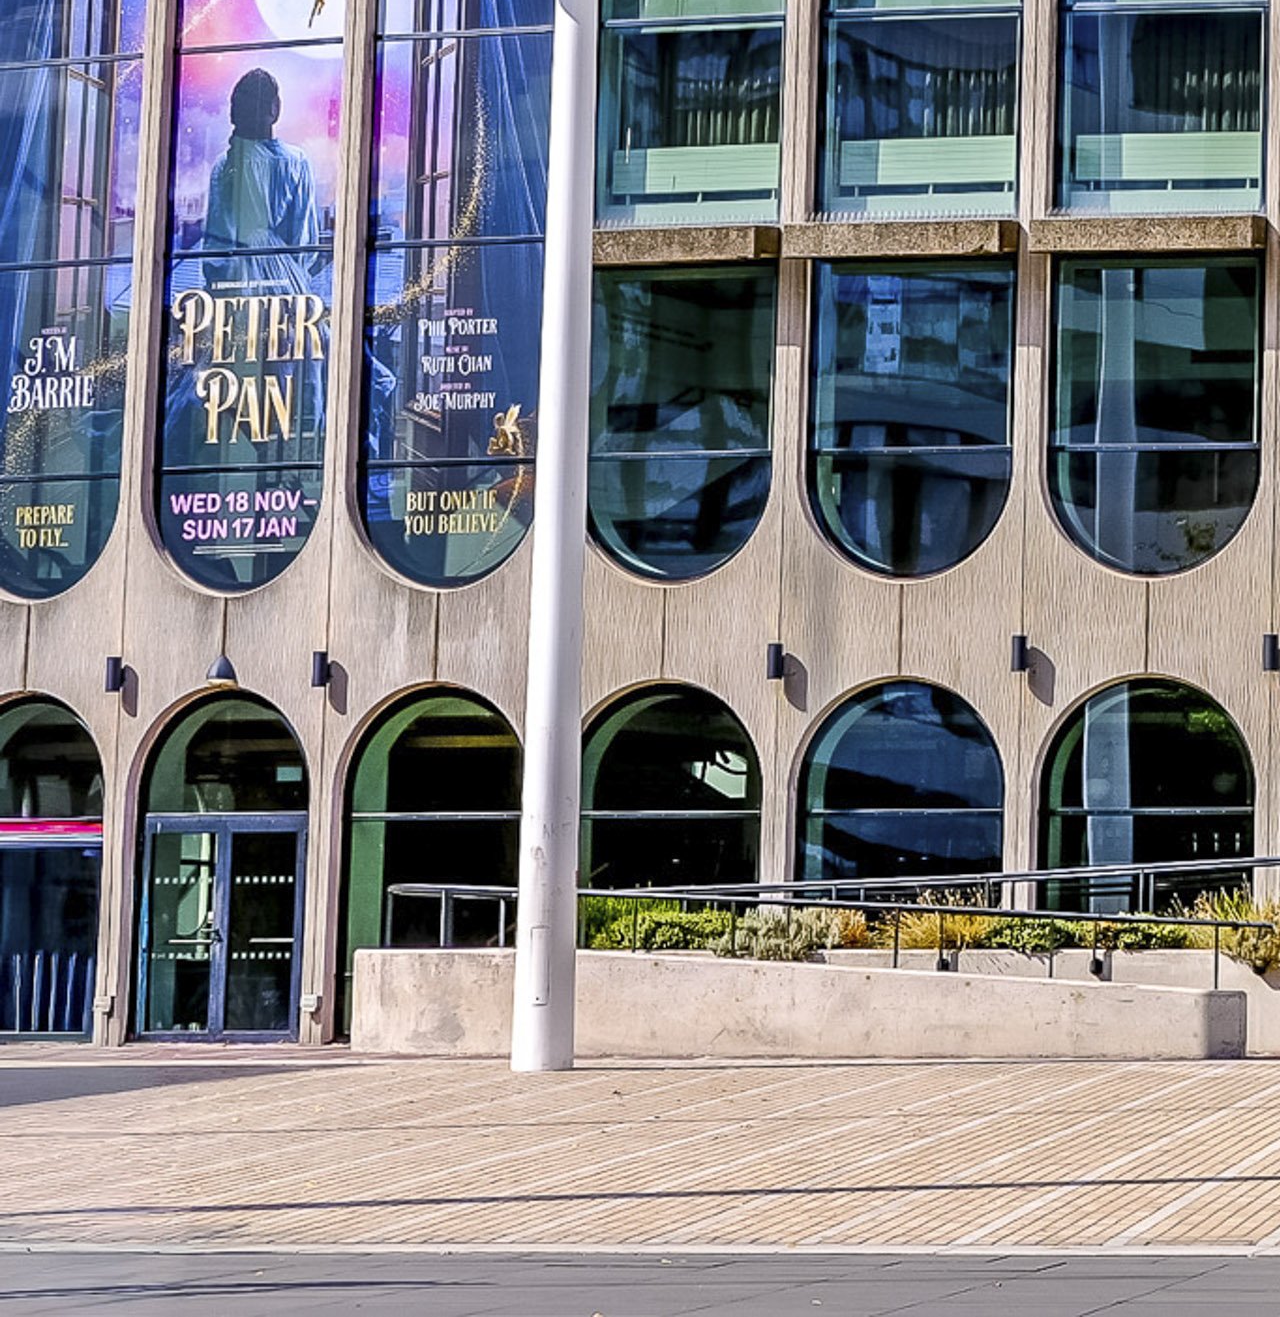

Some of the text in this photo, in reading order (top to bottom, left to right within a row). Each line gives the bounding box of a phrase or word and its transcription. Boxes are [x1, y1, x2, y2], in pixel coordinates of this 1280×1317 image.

[171, 288, 325, 365] PETER
[448, 317, 498, 335] PORTER
[24, 335, 80, 377] J. M.
[421, 355, 455, 376] RUTH
[7, 374, 96, 414] BARRIE
[413, 391, 496, 412] JOE MURPHY
[196, 367, 293, 445] PAN
[170, 492, 221, 515] WED
[224, 491, 249, 513] 18
[254, 489, 301, 512] NOV
[406, 489, 498, 512] BUT ONLY IF
[15, 505, 75, 526] PREPARE
[404, 512, 498, 535] YOU BELIEVE
[19, 528, 37, 548] TO
[181, 516, 297, 541] SUN 17 JAN
